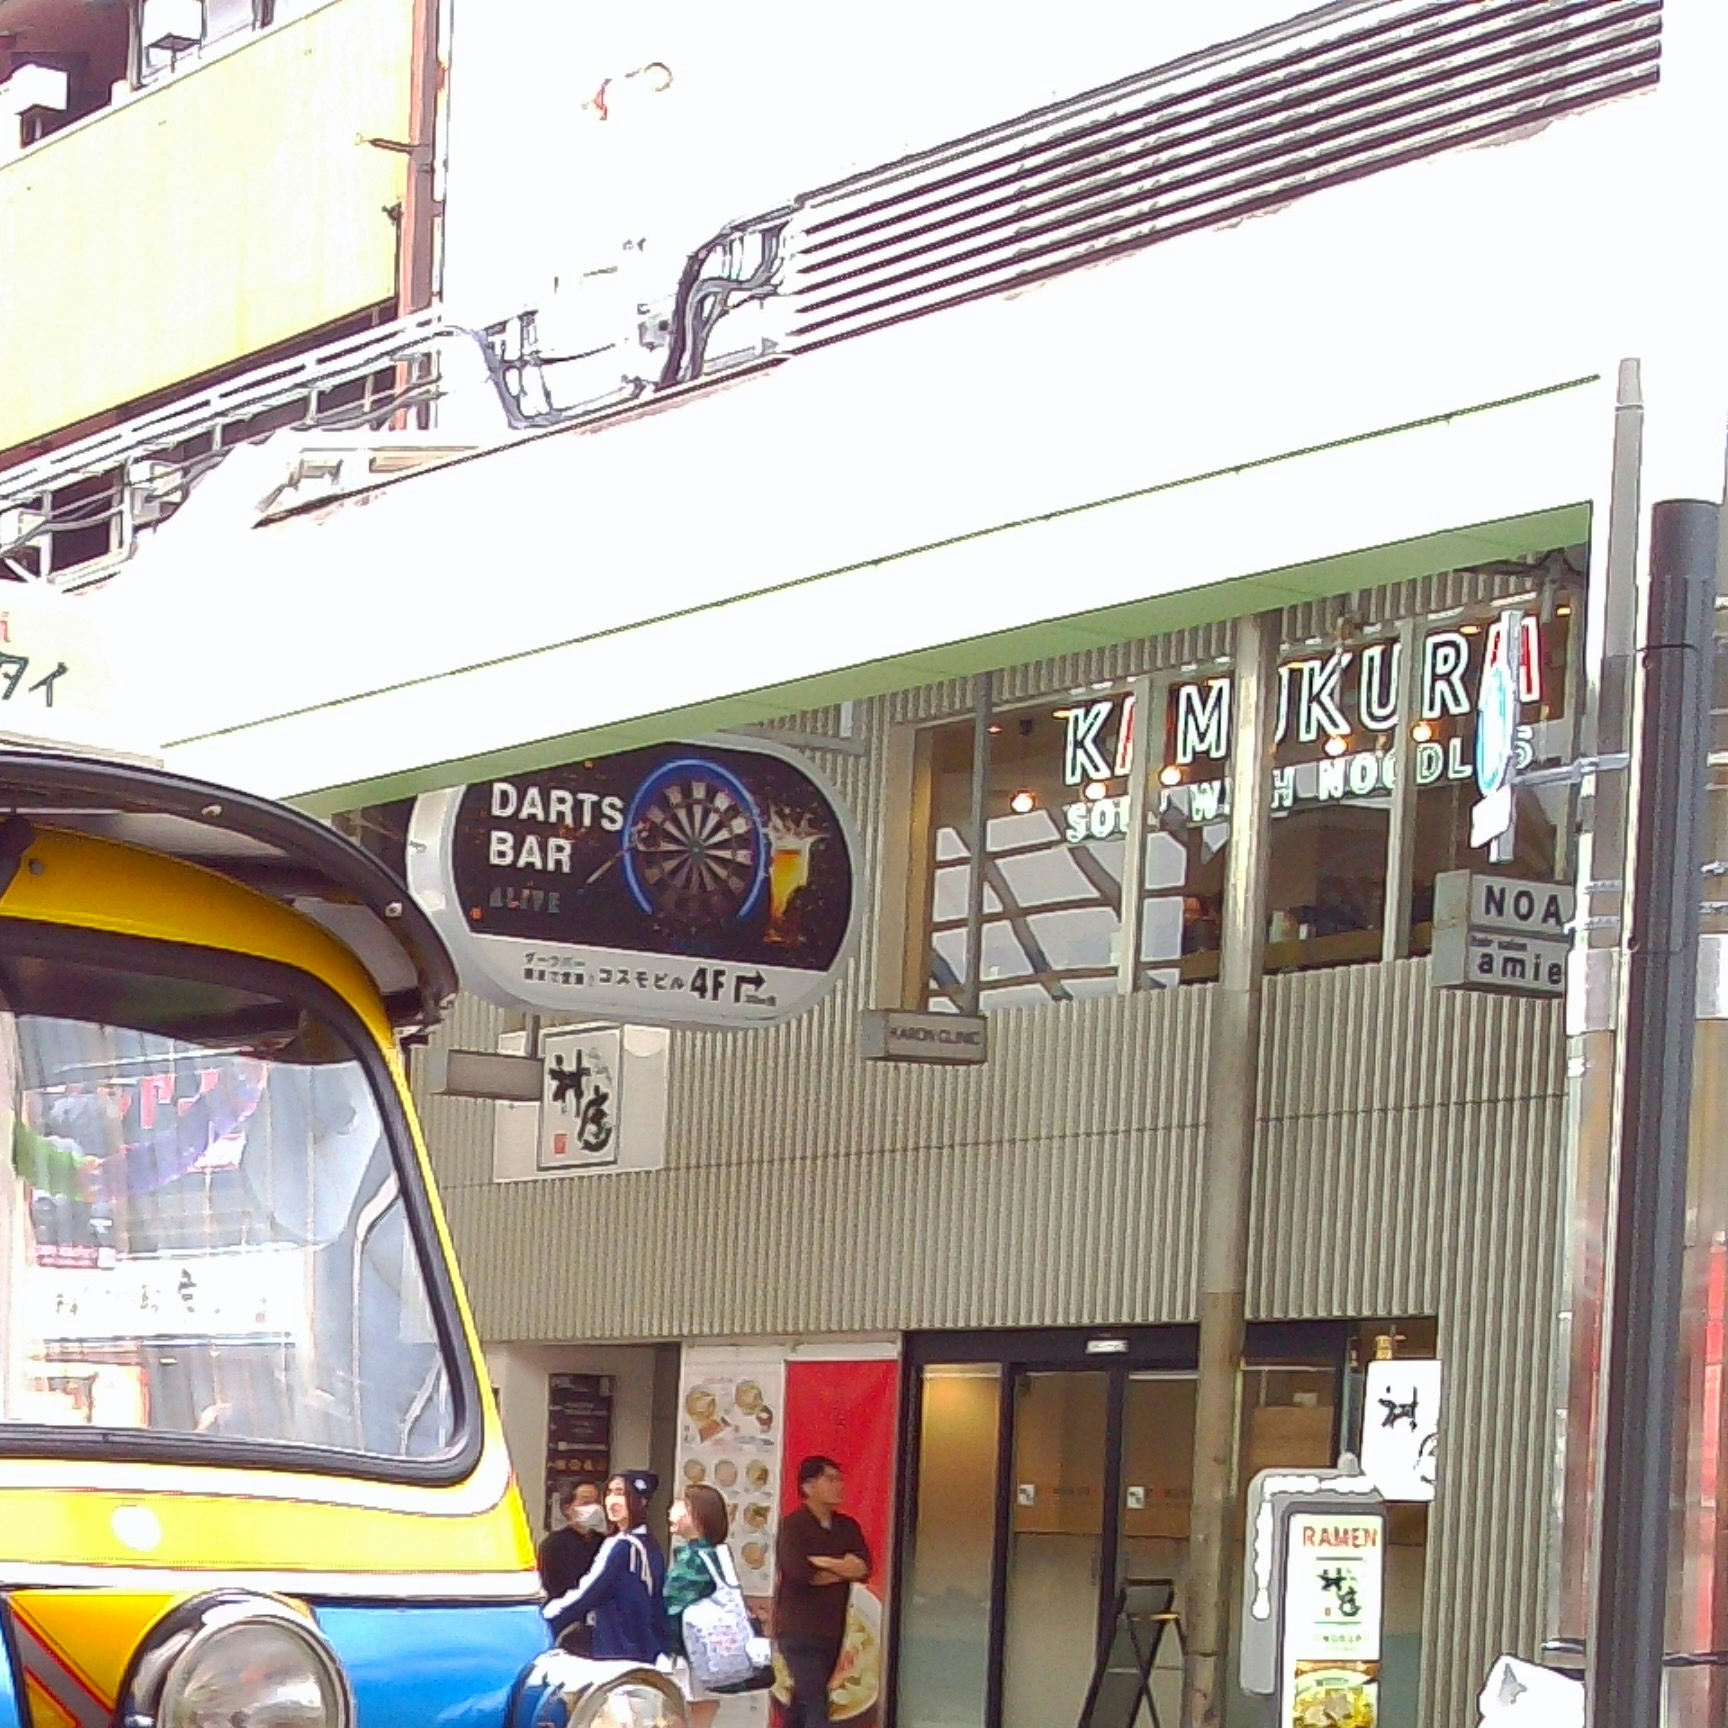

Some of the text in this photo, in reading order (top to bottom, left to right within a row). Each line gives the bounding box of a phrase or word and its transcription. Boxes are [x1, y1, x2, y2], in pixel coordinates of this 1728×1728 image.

[1064, 615, 1540, 785] KMKURA
[1065, 725, 1534, 843] SO WH NOODLS
[490, 781, 626, 832] DARTS
[488, 829, 573, 875] BAR
[1484, 884, 1562, 927] NOA
[689, 965, 726, 1001] 4F
[1477, 952, 1562, 985] amie
[1302, 1525, 1378, 1548] RAMEN
